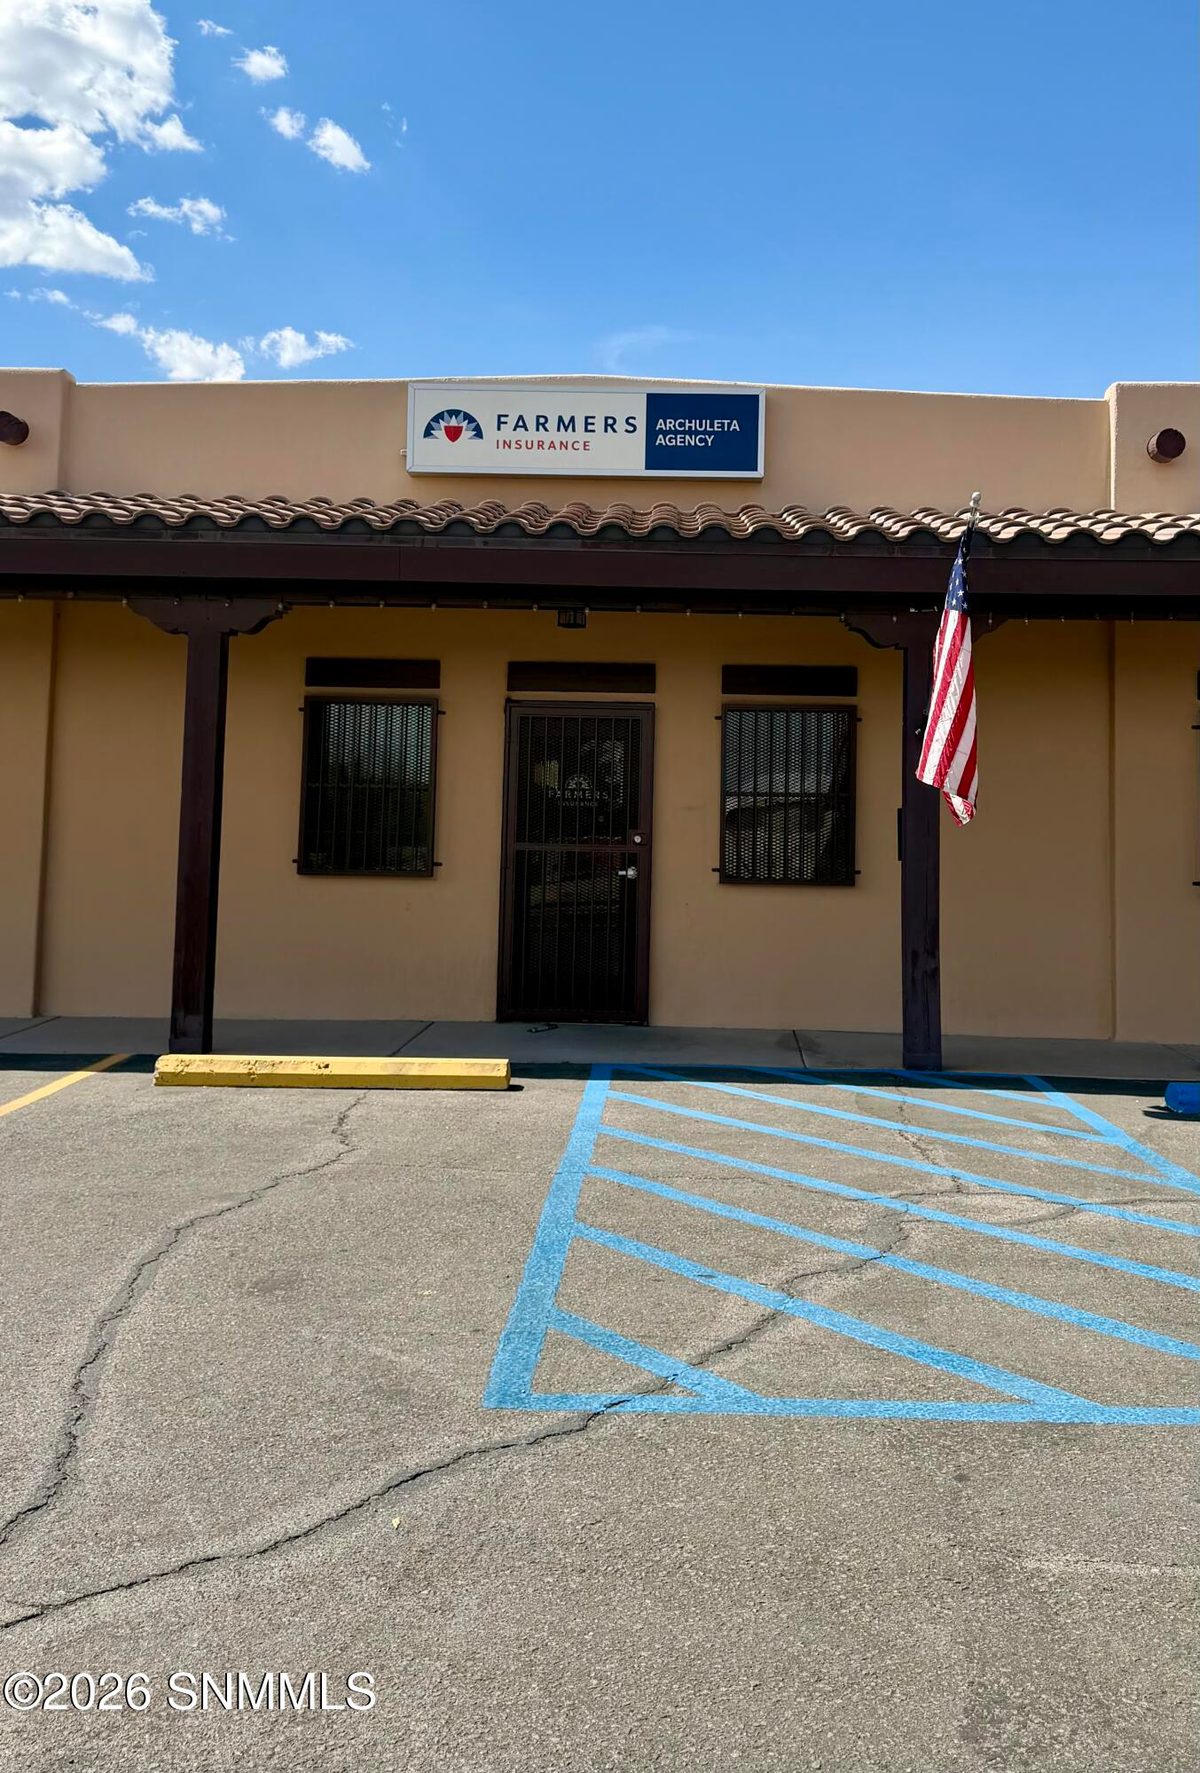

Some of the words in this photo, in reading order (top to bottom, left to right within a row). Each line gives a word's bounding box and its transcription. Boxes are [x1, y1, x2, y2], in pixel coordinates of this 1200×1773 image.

[496, 414, 638, 433] FARMERS
[655, 418, 740, 432] ARCHULETA
[496, 439, 591, 451] INSURANCE
[655, 433, 714, 447] AGENCY
[548, 790, 609, 799] FARMERS
